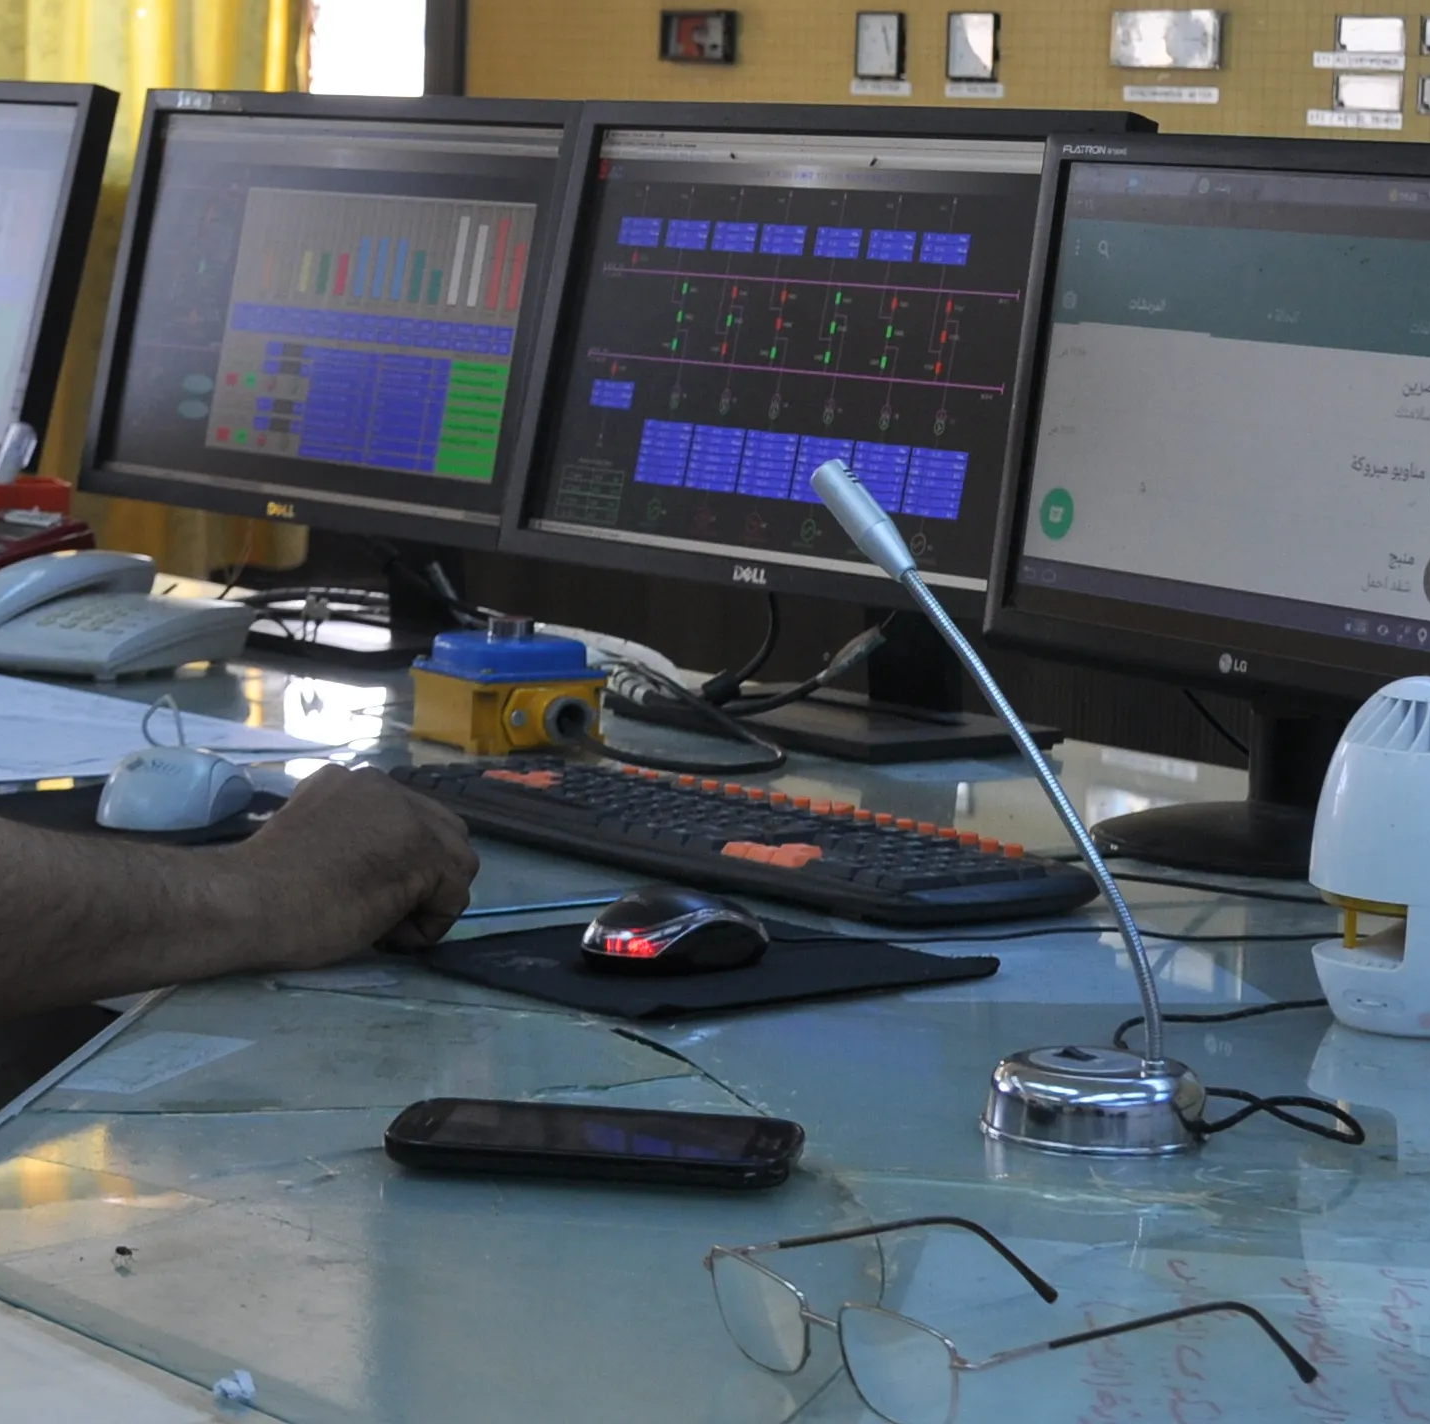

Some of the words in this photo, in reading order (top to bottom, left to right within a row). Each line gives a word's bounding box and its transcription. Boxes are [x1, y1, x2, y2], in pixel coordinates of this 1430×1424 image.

[1063, 145, 1106, 155] FLATRON
[1389, 552, 1414, 570] منبج
[733, 565, 767, 585] DELL
[1234, 658, 1248, 673] LG
